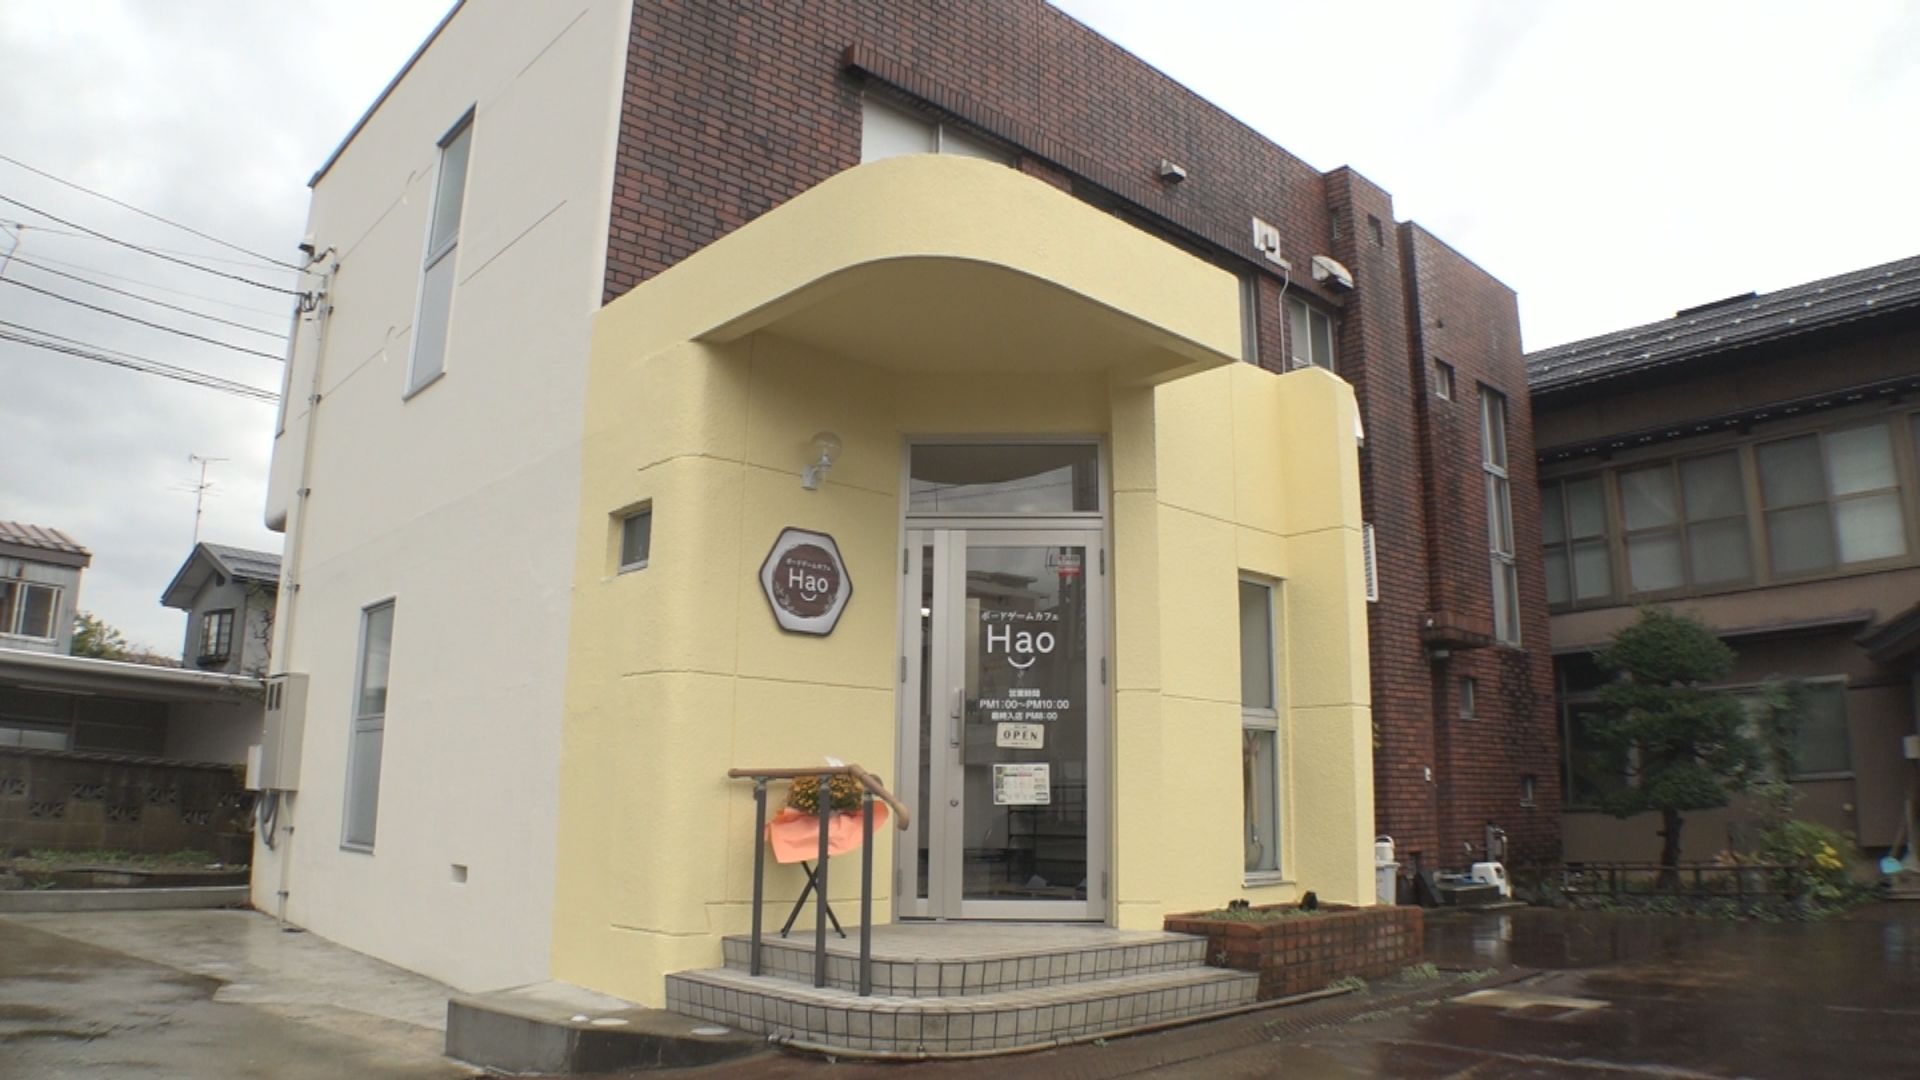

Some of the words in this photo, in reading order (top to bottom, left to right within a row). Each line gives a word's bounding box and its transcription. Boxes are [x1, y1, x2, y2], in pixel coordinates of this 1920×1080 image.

[788, 567, 829, 593] Hao
[981, 611, 1058, 621] ボードゲームカフェ
[987, 624, 1055, 653] Hao
[1003, 730, 1038, 741] OPEN
